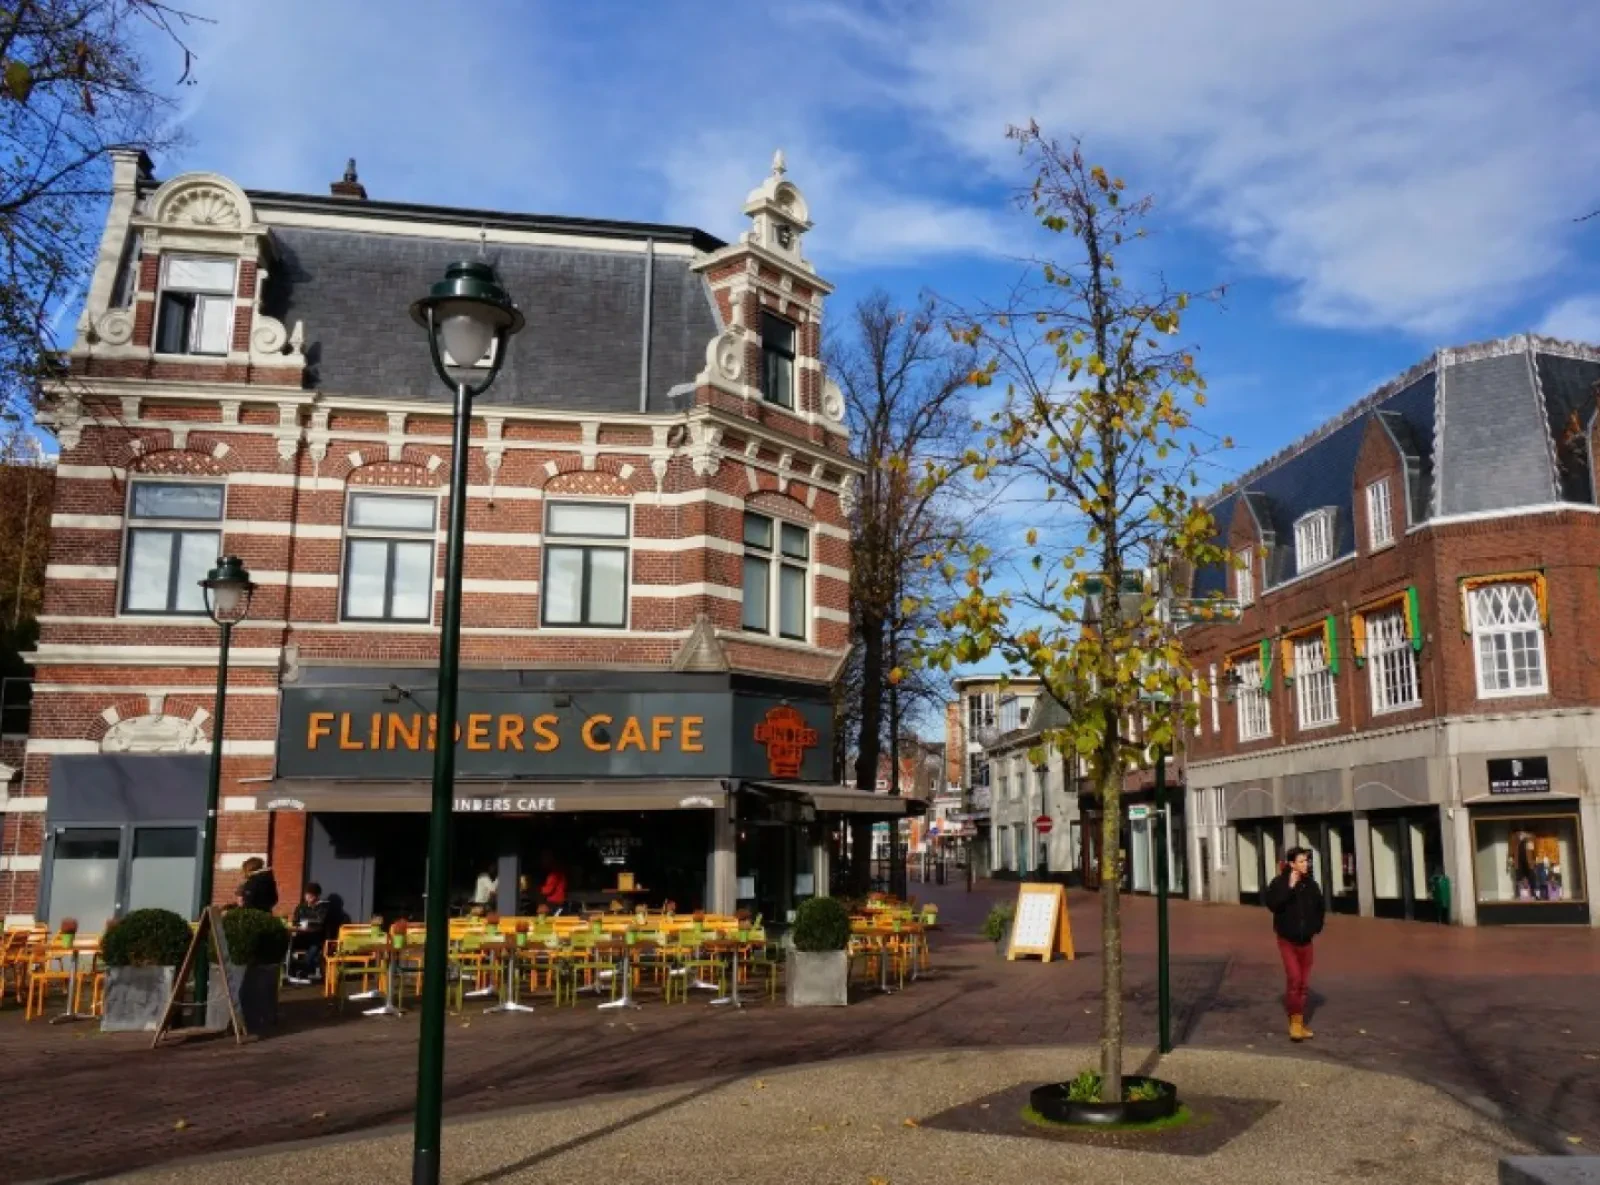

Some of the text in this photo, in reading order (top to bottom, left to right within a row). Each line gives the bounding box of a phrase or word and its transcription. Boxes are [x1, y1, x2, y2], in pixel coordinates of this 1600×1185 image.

[581, 713, 705, 753] CAFE
[452, 797, 556, 811] INDERS CAFE
